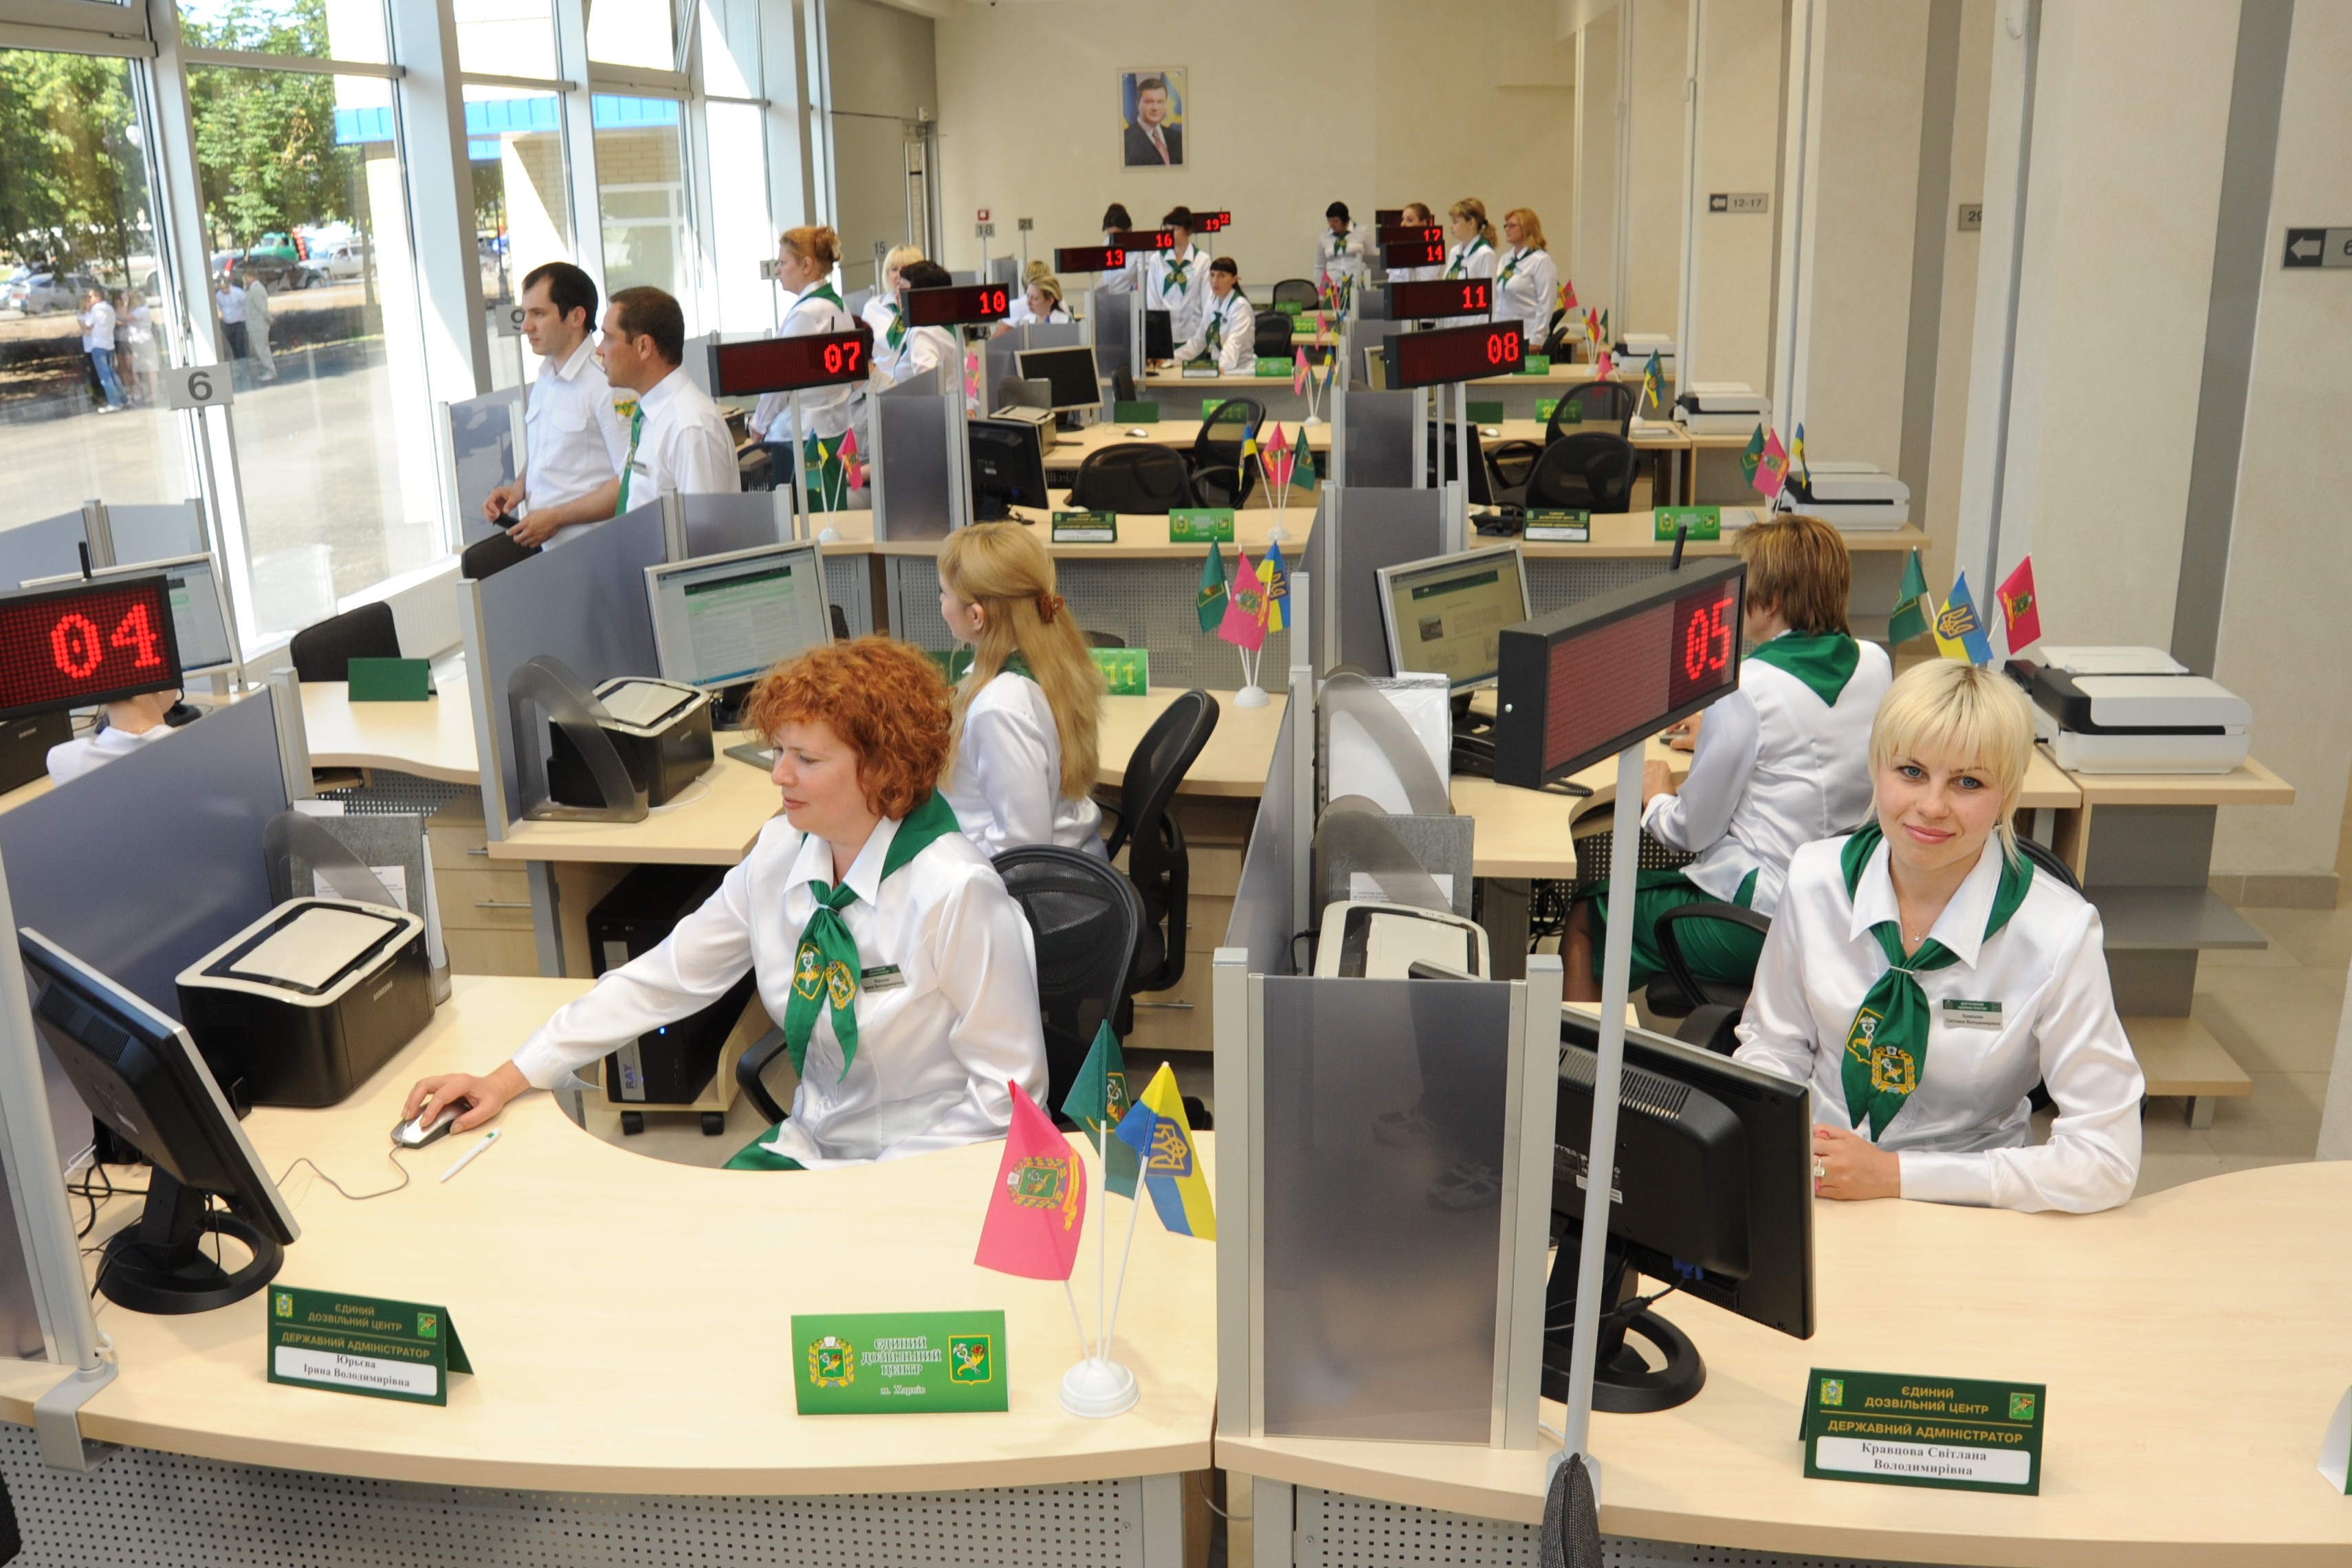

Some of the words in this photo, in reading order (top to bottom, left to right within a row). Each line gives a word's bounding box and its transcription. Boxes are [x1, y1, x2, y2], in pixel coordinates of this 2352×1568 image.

[1734, 198, 1762, 208] 12-17
[1206, 219, 1220, 231] 19
[1219, 213, 1230, 224] 22
[1155, 232, 1172, 247] 16
[1423, 229, 1442, 242] 17
[874, 241, 886, 254] 15
[1427, 245, 1443, 261] 14
[1106, 249, 1124, 267] 13
[980, 290, 1006, 314] 10
[1462, 285, 1487, 309] 11
[511, 307, 526, 330] 9
[824, 341, 860, 373] 07
[1487, 331, 1519, 364] 08
[188, 371, 212, 401] 6
[51, 603, 161, 678] 04
[1685, 597, 1733, 681] 05
[373, 980, 393, 1002] SAMSUNG
[335, 1303, 375, 1317] ЄДИНИЙ
[308, 1312, 369, 1327] ДОЗВІЛЬНИЙ
[371, 1320, 402, 1332] ЦЕНТР
[282, 1331, 344, 1348] ДЕРЖАВНИЙ
[347, 1340, 430, 1358] АДМІНІСТРАТОР
[303, 1363, 331, 1376] Ірина
[334, 1368, 410, 1387] Володимирівна
[1902, 1386, 1954, 1399] ЄДИНИЙ
[1865, 1397, 1946, 1411] ДОЗВІЛЬНИЙ
[1949, 1403, 1989, 1414] ЦЕНТР
[1827, 1420, 1912, 1435] ДЕРЖАВНИЙ
[1915, 1428, 2023, 1444] АДМІНІСТРАТОР
[1862, 1442, 1924, 1458] Кравцова
[1928, 1446, 1987, 1461] Світлана
[1873, 1459, 1972, 1476] Володимирівна
